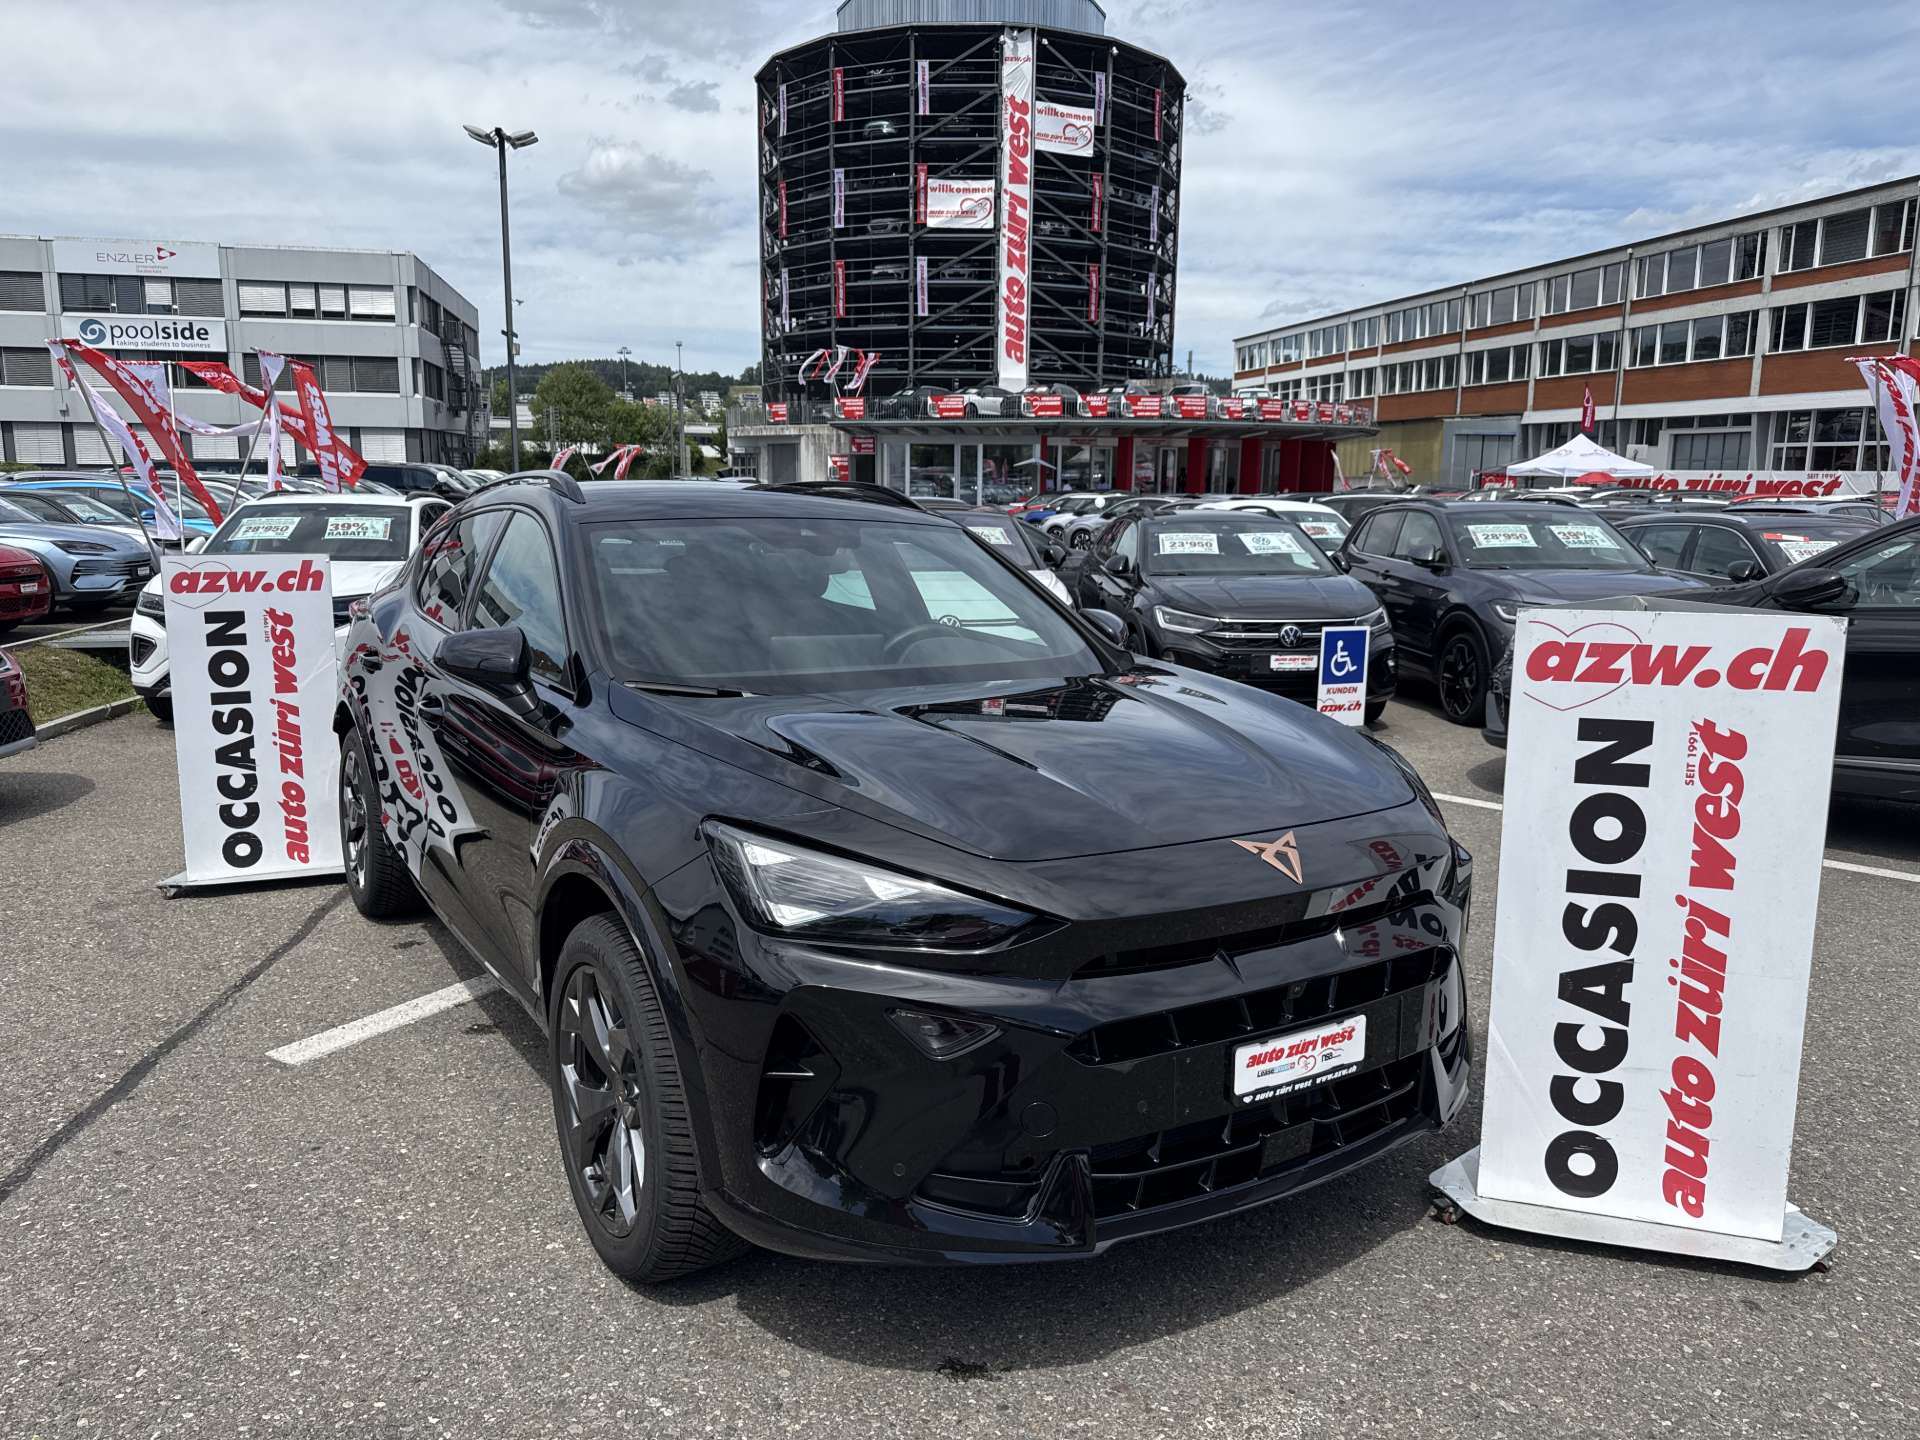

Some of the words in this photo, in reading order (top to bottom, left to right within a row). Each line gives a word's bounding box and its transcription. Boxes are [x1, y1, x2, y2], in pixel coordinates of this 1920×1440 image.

[1036, 106, 1093, 122] willkommen
[1008, 94, 1030, 185] west
[929, 184, 993, 194] willkommen
[1002, 188, 1028, 275] züri
[96, 252, 155, 264] ENZLER
[110, 320, 209, 346] poolside
[1002, 276, 1025, 364] auto
[116, 340, 138, 348] taking
[140, 340, 171, 348] students
[181, 341, 211, 349] business
[304, 382, 332, 446] west
[1756, 473, 1845, 497] west
[329, 522, 369, 531] 39%
[170, 560, 324, 594] azw.ch
[268, 607, 298, 694] west
[1525, 628, 1829, 693] azw.ch
[1320, 700, 1362, 713] azw.ch
[1326, 687, 1358, 695] KUNDEN
[204, 610, 263, 868] OCCASION
[270, 698, 304, 779] züri
[1687, 731, 1698, 757] 1991
[1685, 763, 1696, 786] SEIT
[276, 781, 310, 864] auto
[1688, 718, 1748, 890] west
[1545, 717, 1655, 1198] OCCASION
[1669, 894, 1732, 1060] züri
[1246, 1046, 1285, 1069] auto
[1286, 1035, 1320, 1058] züri
[1320, 1026, 1356, 1048] west
[1255, 1089, 1273, 1101] auto
[1294, 1079, 1313, 1091] west
[1659, 1055, 1717, 1218] auto
